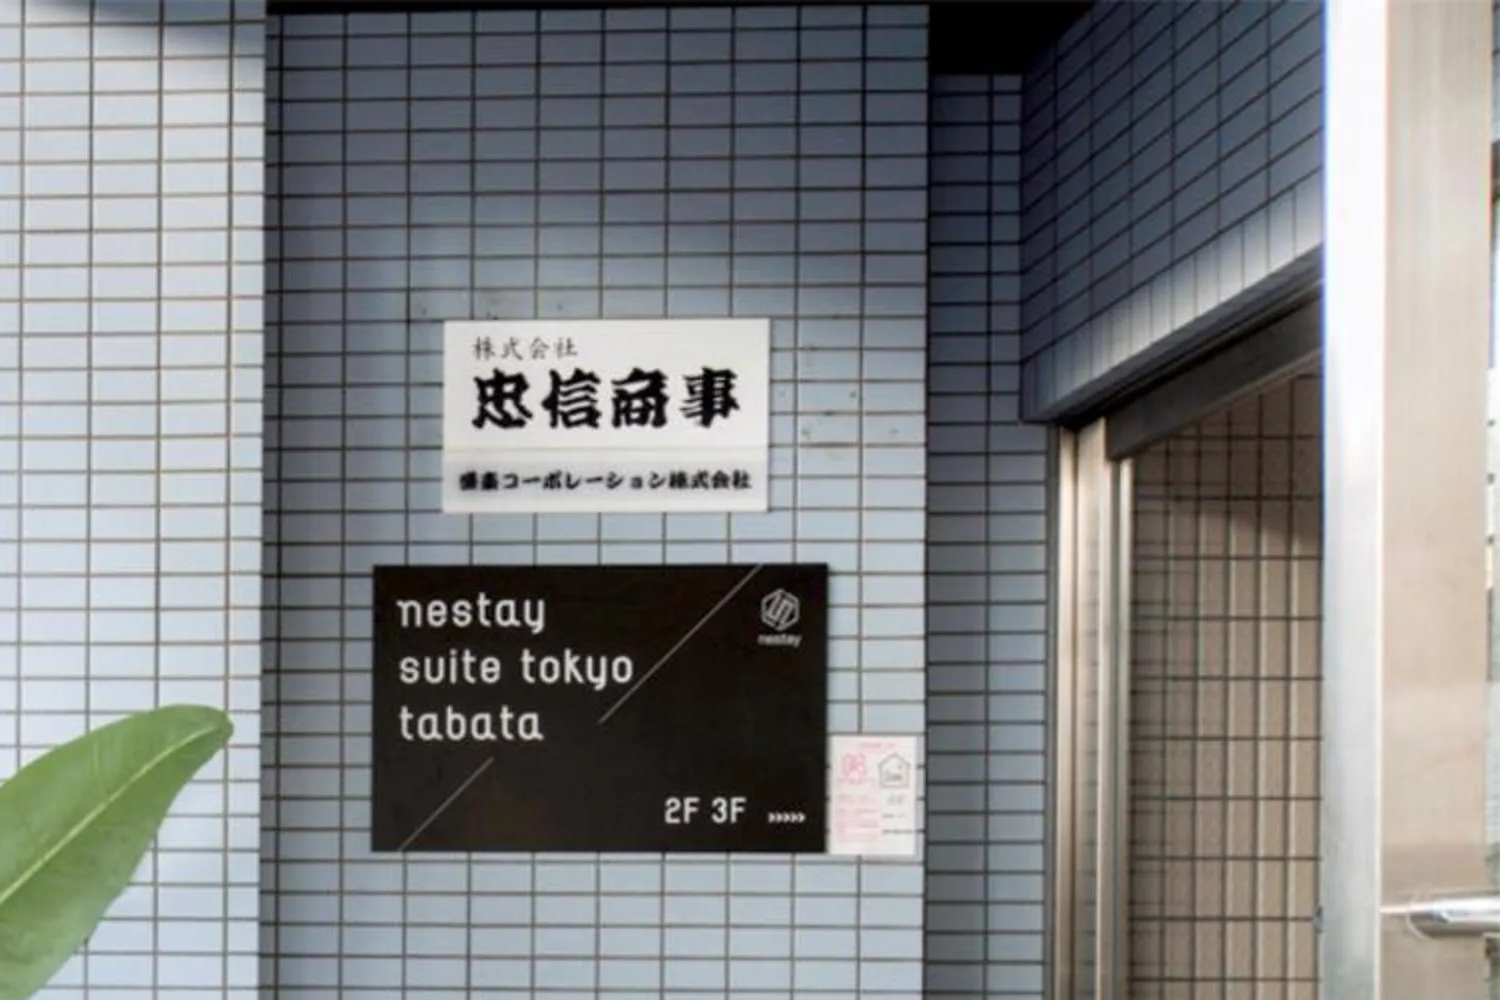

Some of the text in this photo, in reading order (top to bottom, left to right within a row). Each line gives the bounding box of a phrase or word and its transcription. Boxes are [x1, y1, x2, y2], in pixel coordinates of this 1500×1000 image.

[472, 336, 578, 361] 株式会社
[471, 367, 740, 430] 忠信商事
[396, 592, 545, 634] nestay
[757, 633, 802, 648] nestay
[400, 648, 633, 691] suite tokyo
[399, 705, 544, 741] tabata
[664, 796, 747, 824] 2F 3F
